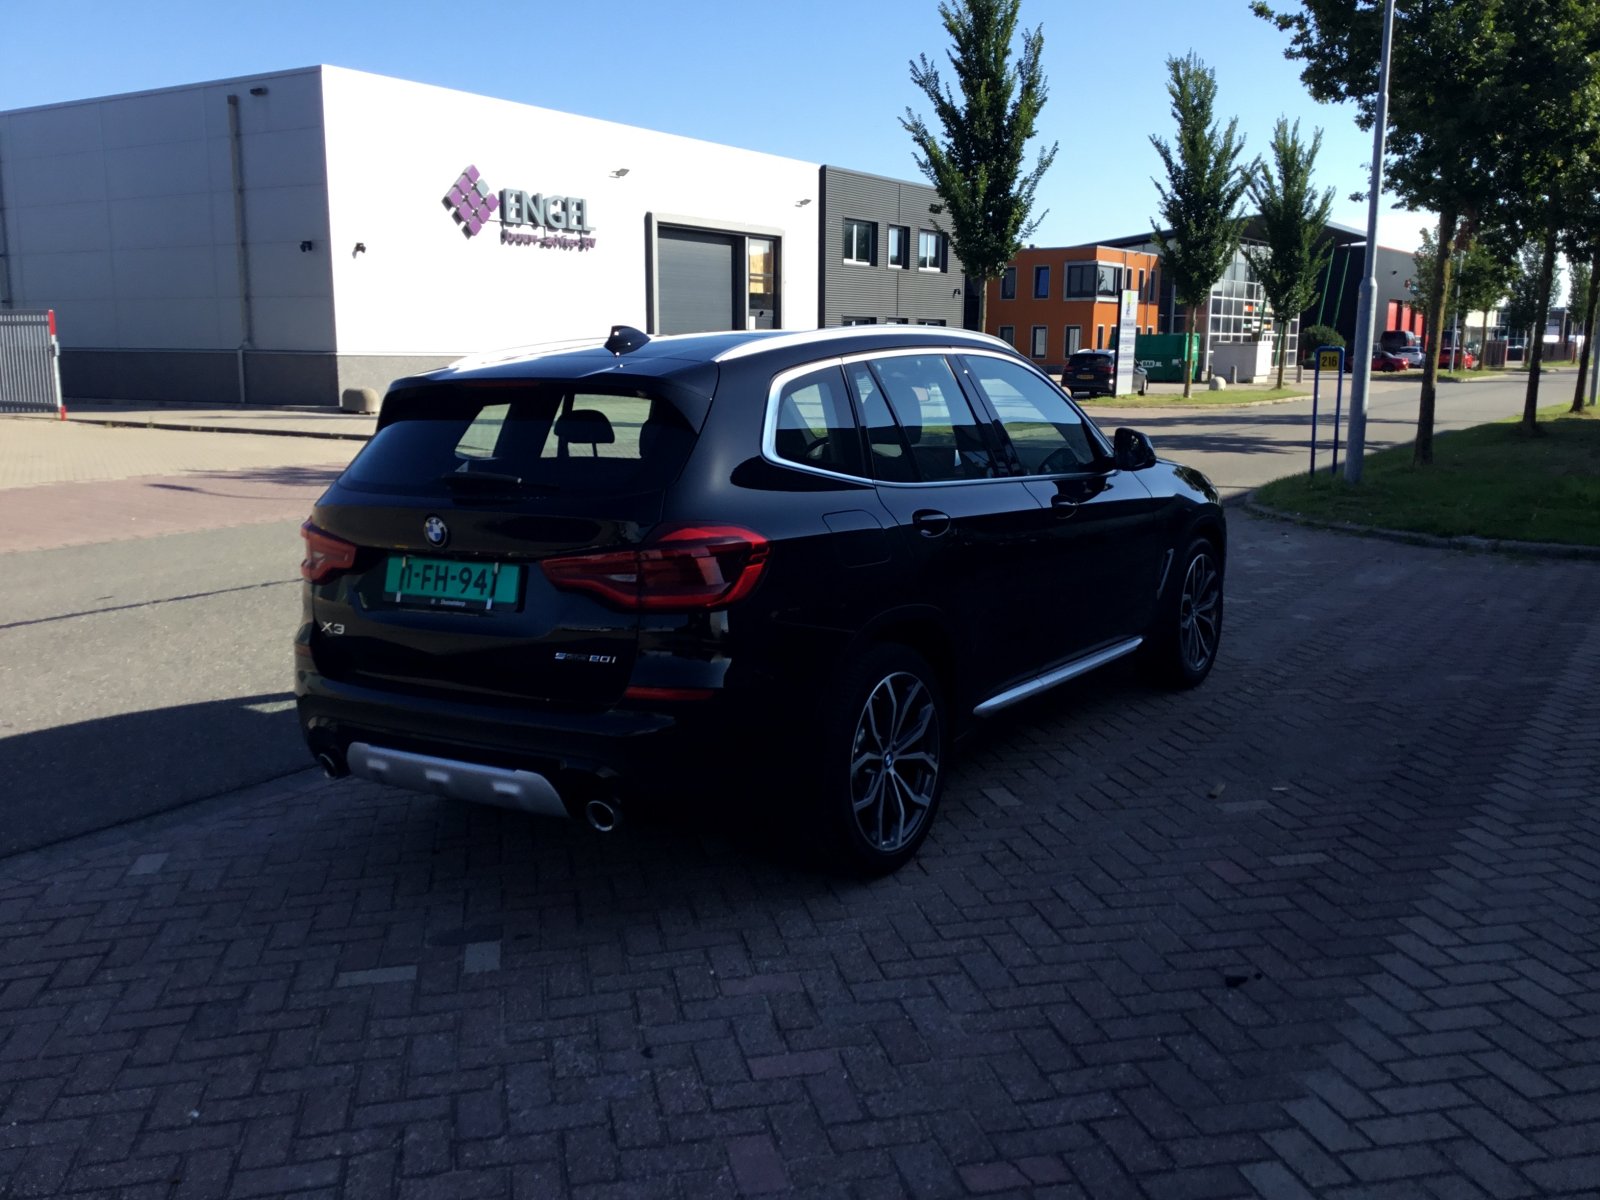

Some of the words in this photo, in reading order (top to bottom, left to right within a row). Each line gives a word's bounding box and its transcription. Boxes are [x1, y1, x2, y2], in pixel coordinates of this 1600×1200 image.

[499, 188, 596, 233] ENGEL
[1321, 355, 1338, 368] 216
[319, 620, 345, 635] X3
